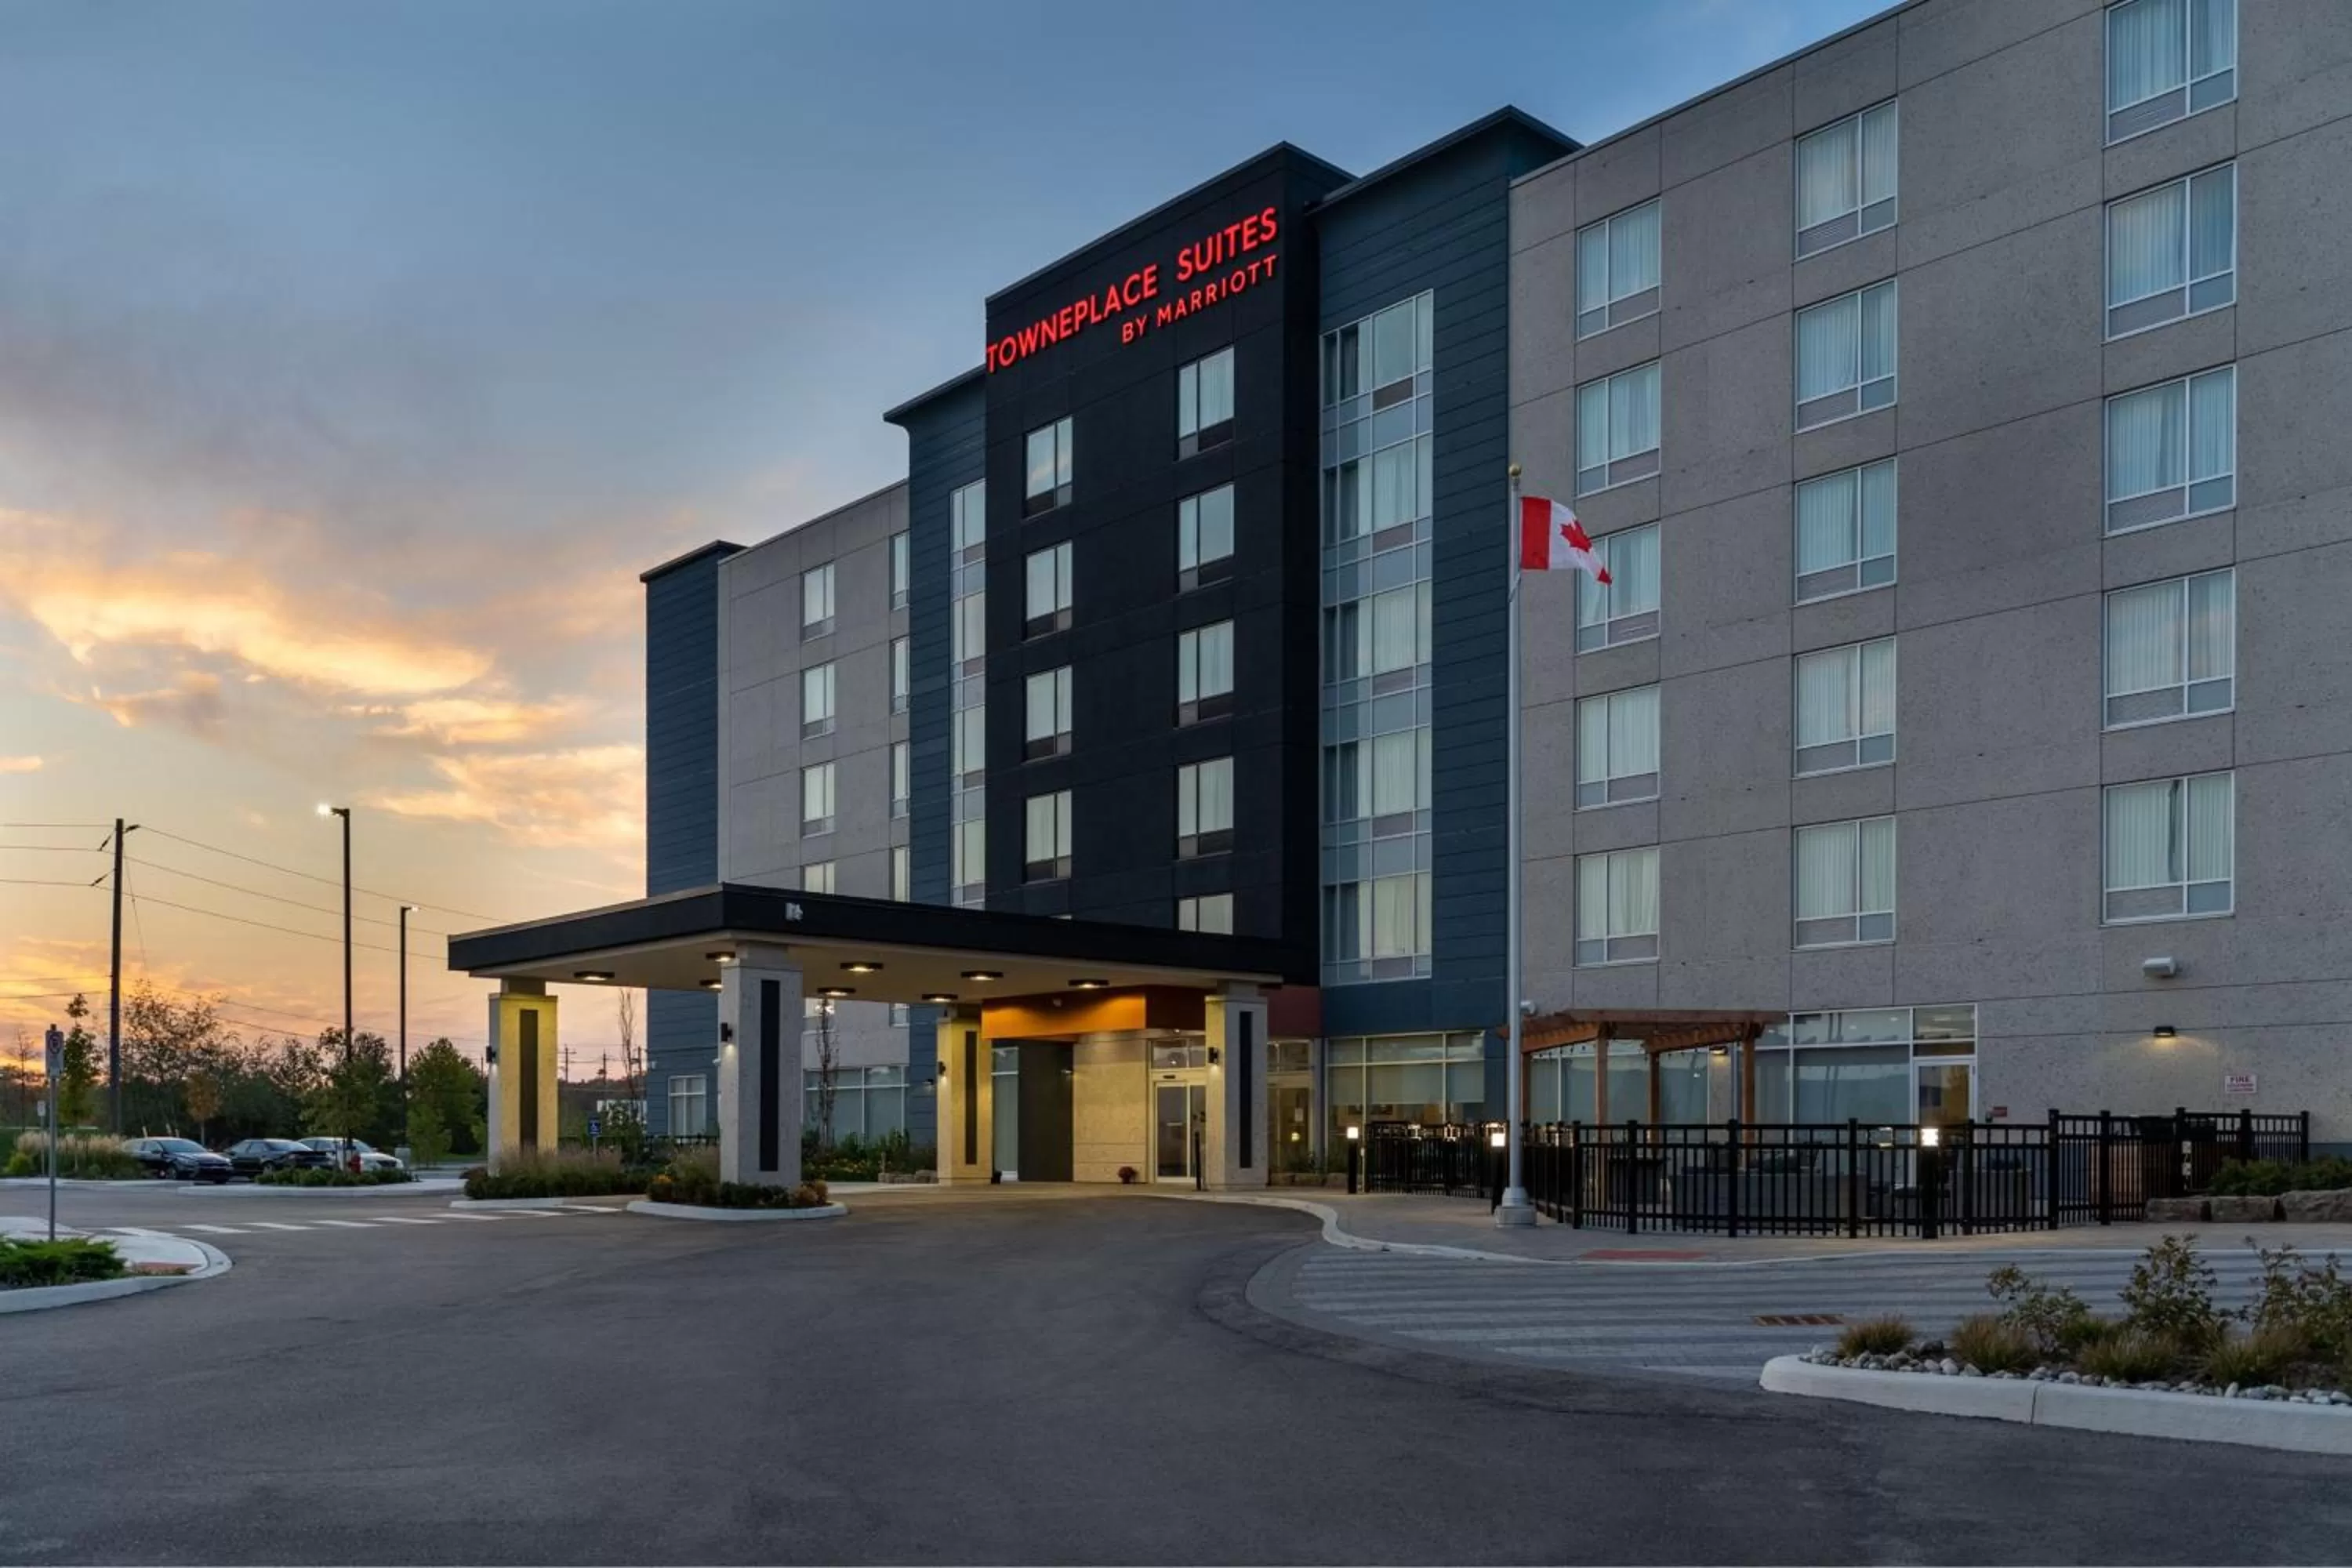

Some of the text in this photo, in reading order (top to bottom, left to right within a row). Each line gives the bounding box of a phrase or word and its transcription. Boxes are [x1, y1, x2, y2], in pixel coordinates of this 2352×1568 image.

[986, 206, 1278, 373] TOWNEPLACE SUITES
[1121, 254, 1277, 344] BY MARRIOTT
